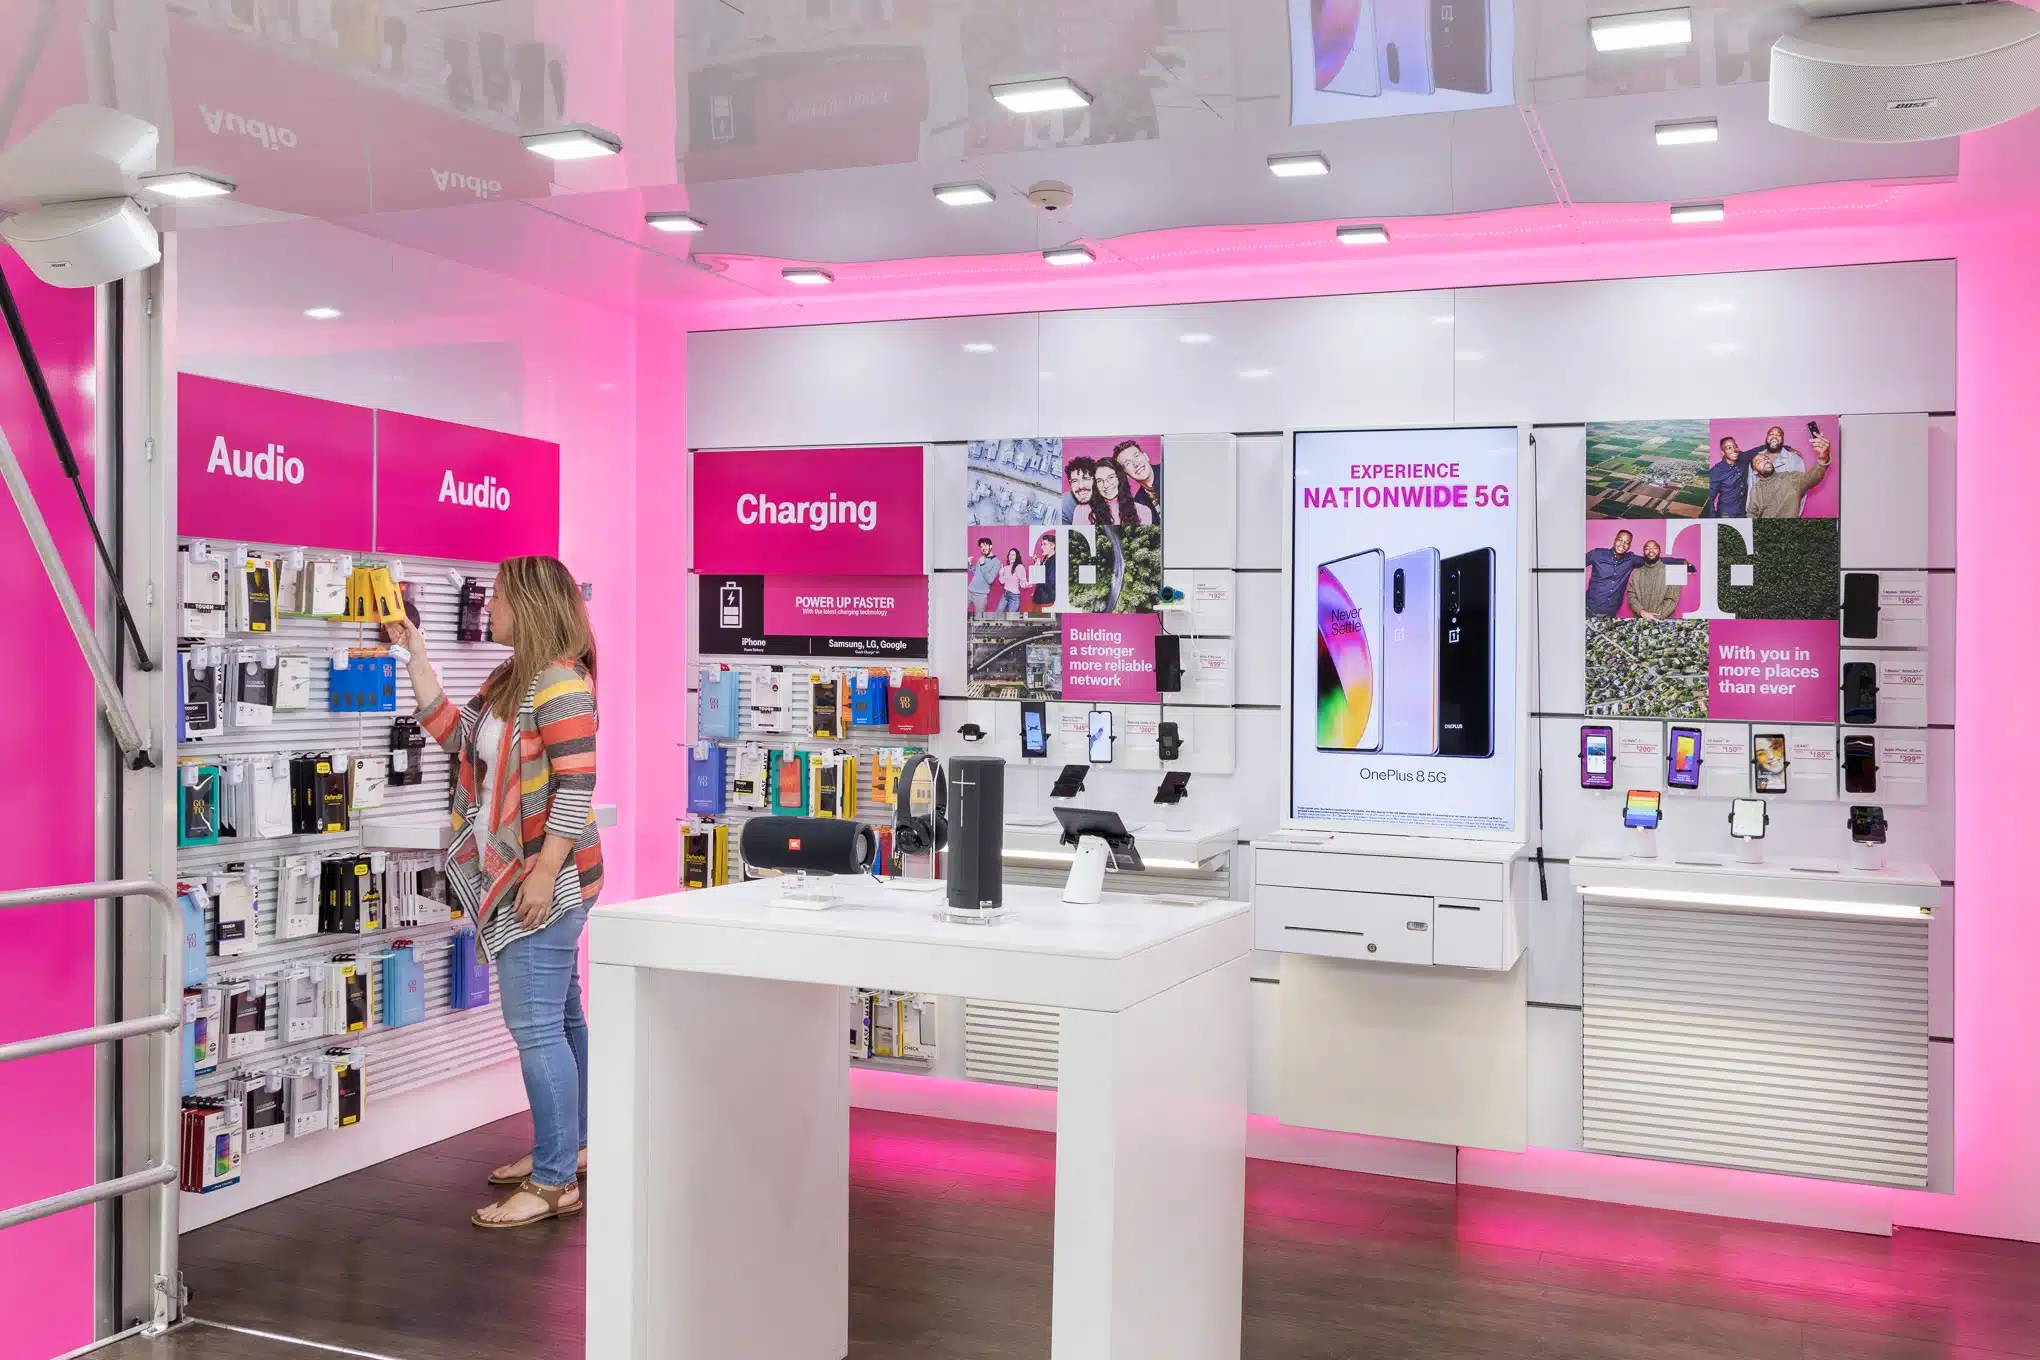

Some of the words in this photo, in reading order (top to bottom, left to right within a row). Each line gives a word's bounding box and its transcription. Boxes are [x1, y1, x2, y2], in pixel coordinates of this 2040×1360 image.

[207, 436, 305, 485] Audio
[1350, 463, 1460, 479] EXPERIENCE
[438, 469, 511, 512] Audio
[1304, 486, 1468, 508] NATIONWIDE
[1474, 485, 1510, 507] 5G
[736, 493, 877, 531] Charging
[795, 596, 834, 608] POWER
[836, 597, 851, 608] UP
[853, 597, 895, 609] FASTER
[1331, 607, 1362, 622] Never
[1069, 628, 1122, 644] Building
[1331, 620, 1361, 636] Settle
[741, 637, 766, 646] iPhone
[828, 639, 865, 649] Samsung,
[866, 640, 879, 649] LG,
[880, 640, 907, 651] Google
[1069, 646, 1077, 656] a
[1080, 645, 1135, 659] stronger
[1718, 645, 1755, 660] With
[1760, 650, 1790, 663] you
[1794, 646, 1810, 660] in
[1069, 661, 1102, 670] more
[1105, 659, 1152, 672] reliable
[1718, 666, 1760, 677] more
[1764, 664, 1820, 680] places
[1069, 674, 1122, 686] network
[1718, 679, 1755, 694] than
[1759, 683, 1796, 695] ever
[1359, 767, 1414, 782] OnePlus
[1416, 770, 1425, 783] 8
[1427, 771, 1447, 784] 5G
[192, 799, 204, 807] GO
[193, 807, 204, 815] TO
